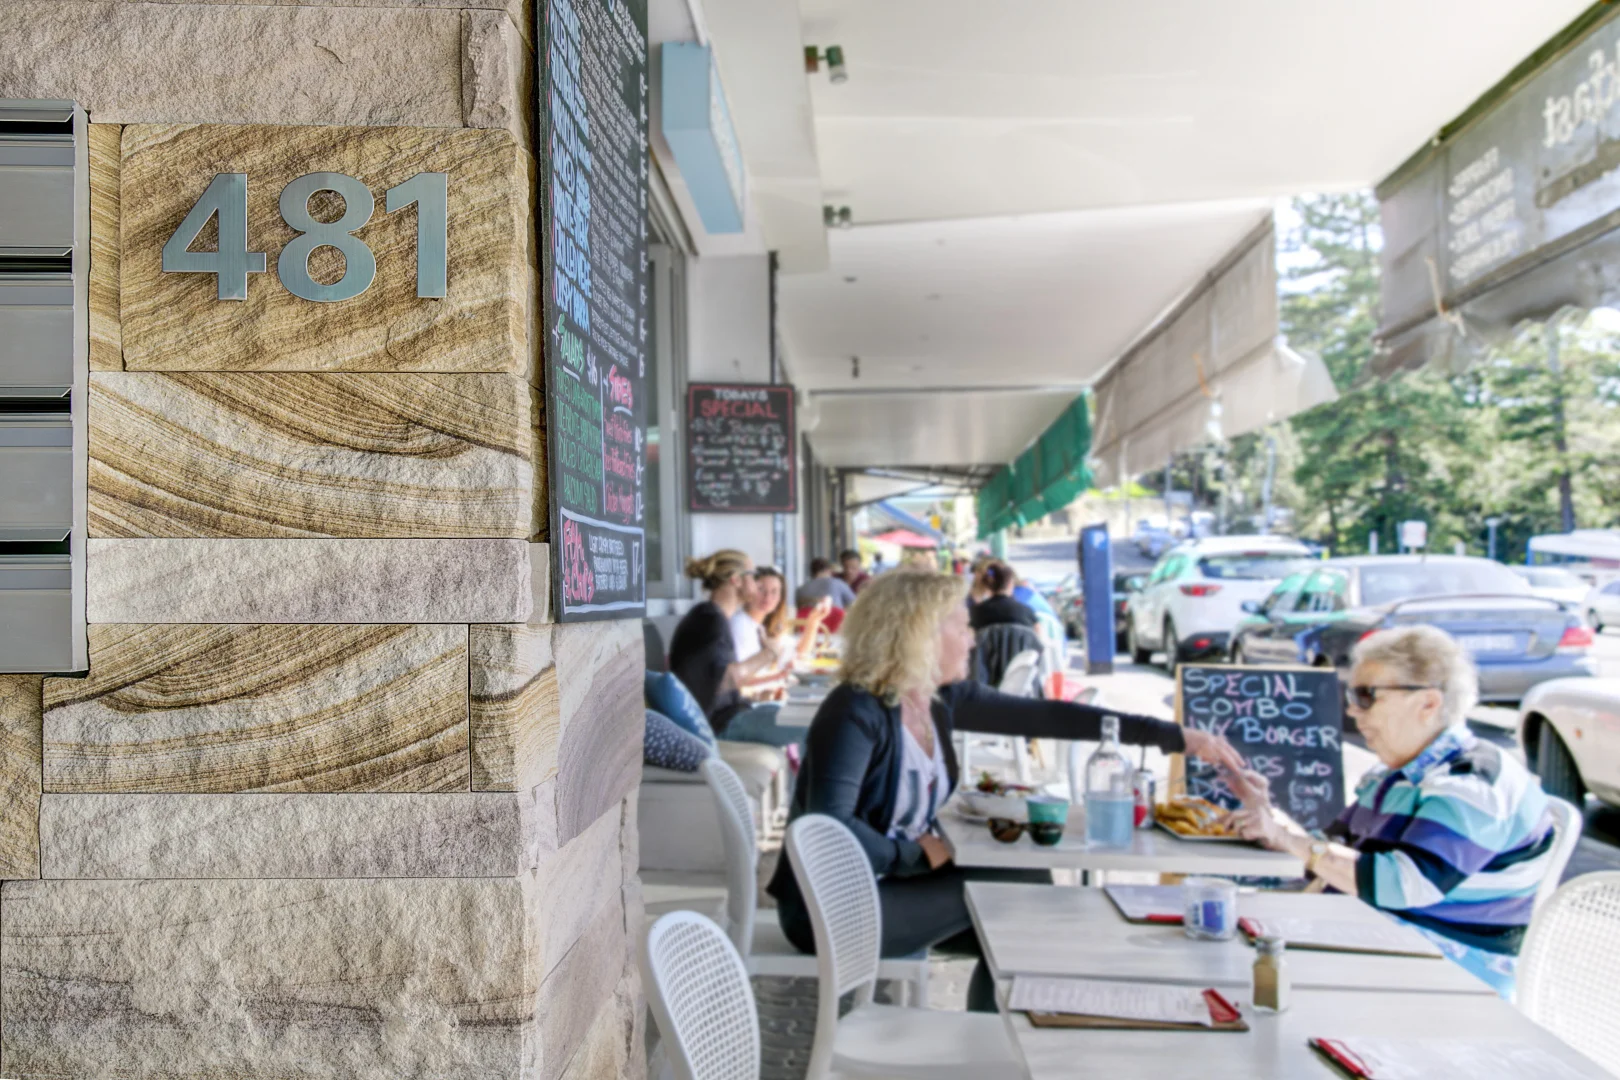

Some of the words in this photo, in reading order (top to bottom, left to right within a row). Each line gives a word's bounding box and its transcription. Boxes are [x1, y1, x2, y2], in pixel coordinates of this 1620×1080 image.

[162, 171, 448, 302] 481
[701, 400, 779, 418] SPECIAL
[1184, 668, 1313, 700] SPECIAL
[1189, 697, 1313, 719] COMBO
[1235, 715, 1340, 750] BURGER
